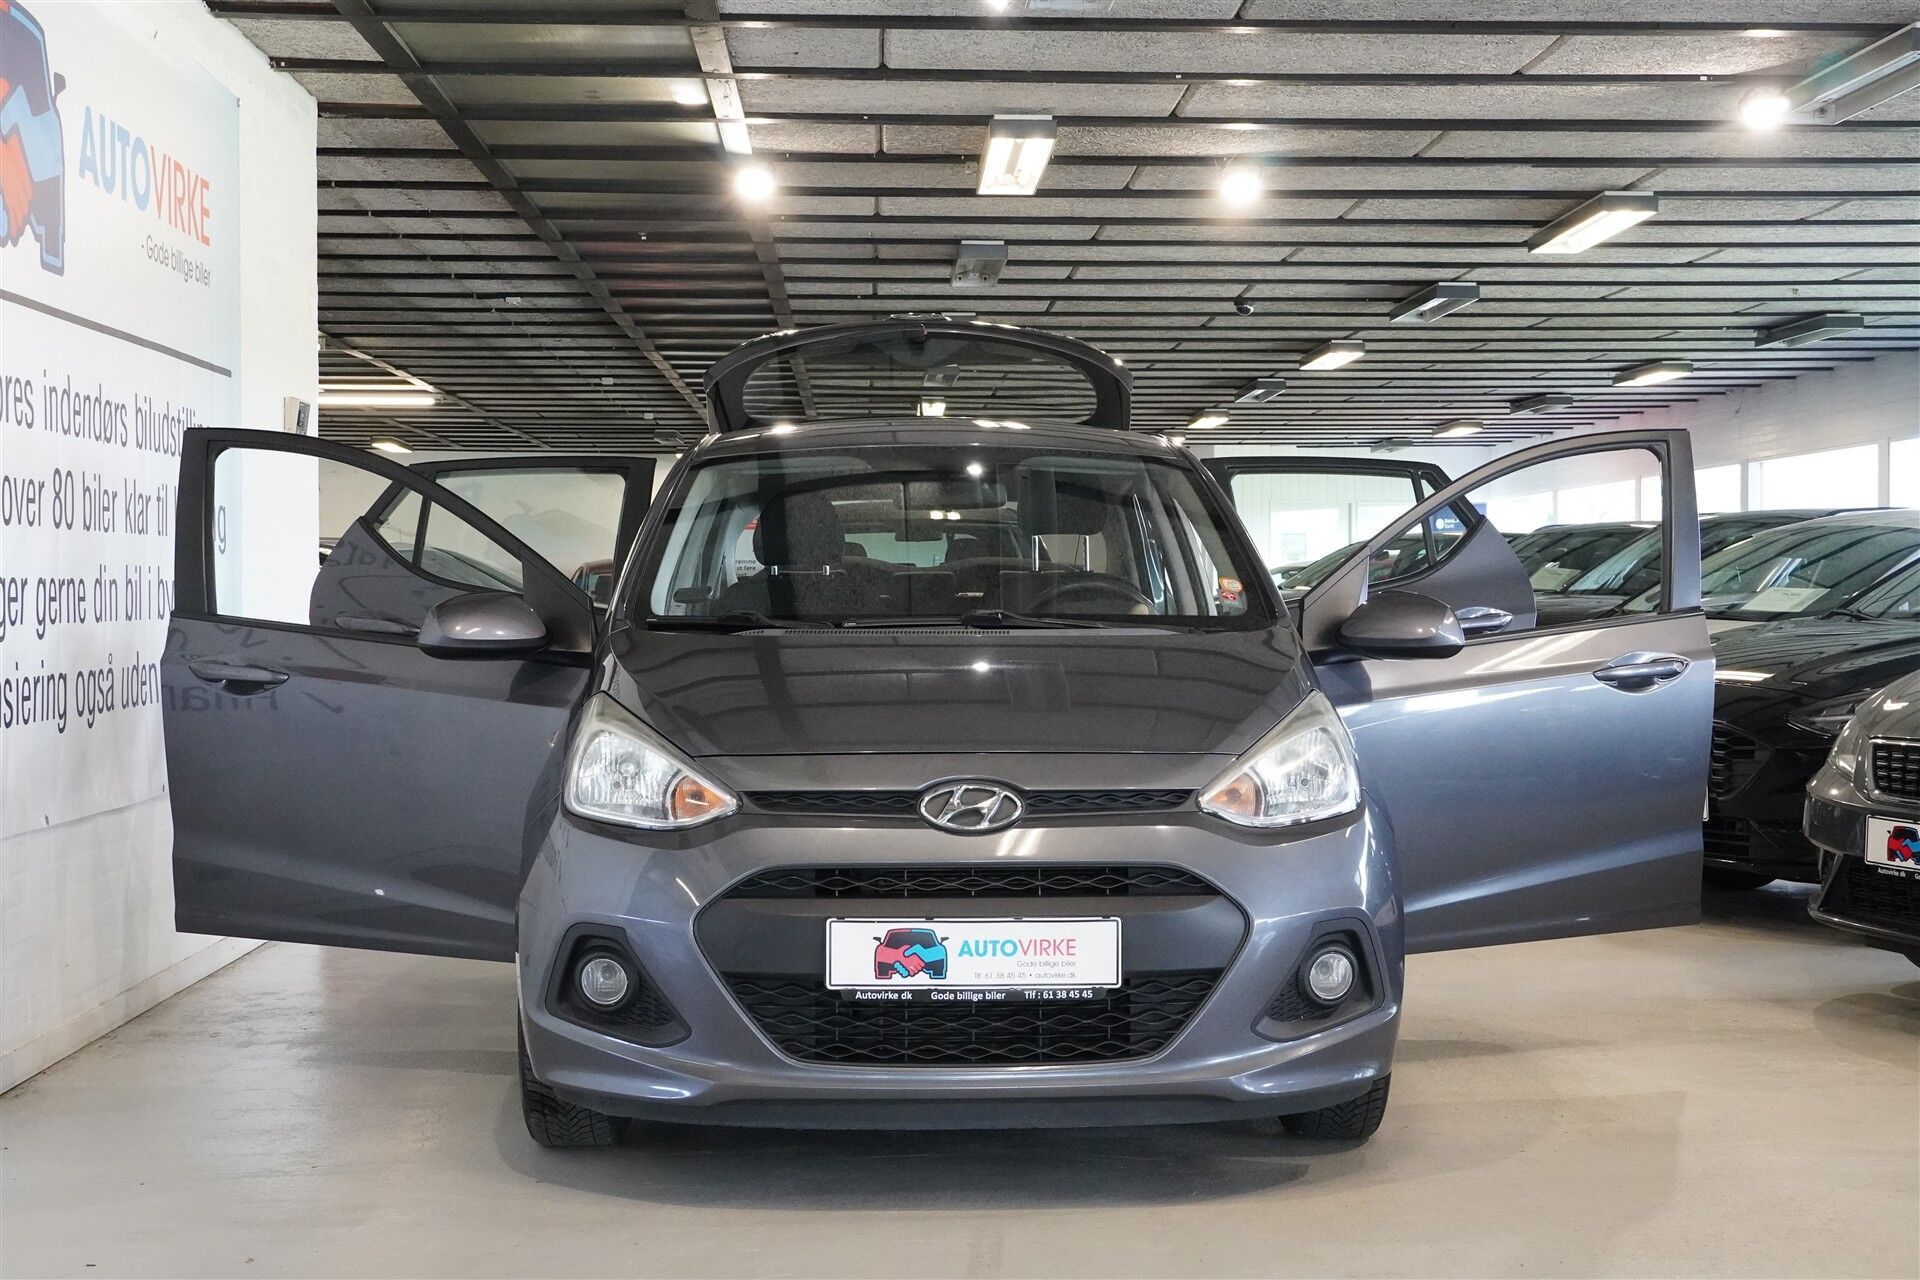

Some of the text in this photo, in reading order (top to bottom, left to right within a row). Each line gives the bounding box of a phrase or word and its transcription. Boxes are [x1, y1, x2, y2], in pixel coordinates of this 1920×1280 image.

[79, 105, 211, 247] AUTOVIRKE
[146, 234, 170, 267] Gode
[171, 246, 194, 283] billige
[195, 258, 211, 287] biler
[44, 368, 129, 448] indendørs
[1, 475, 45, 527] over
[53, 467, 75, 530] 80
[82, 471, 118, 533] biler
[124, 478, 151, 535] klar
[157, 483, 168, 536] til
[36, 577, 87, 640] gerne
[93, 564, 118, 624] din
[125, 564, 142, 622] bil
[148, 566, 152, 620] i
[0, 651, 160, 734] siering også uden
[958, 938, 1077, 957] AUTOVIRKE
[1016, 960, 1037, 968] Gode
[855, 990, 899, 1000] Autovirke
[930, 991, 955, 1000] Gode
[956, 991, 983, 1002] billige
[985, 991, 1006, 1000] biler
[1024, 990, 1036, 999] Tlf
[1042, 990, 1054, 999] 61
[1055, 990, 1067, 999] 38
[1068, 990, 1080, 999] 45
[1081, 990, 1093, 999] 45
